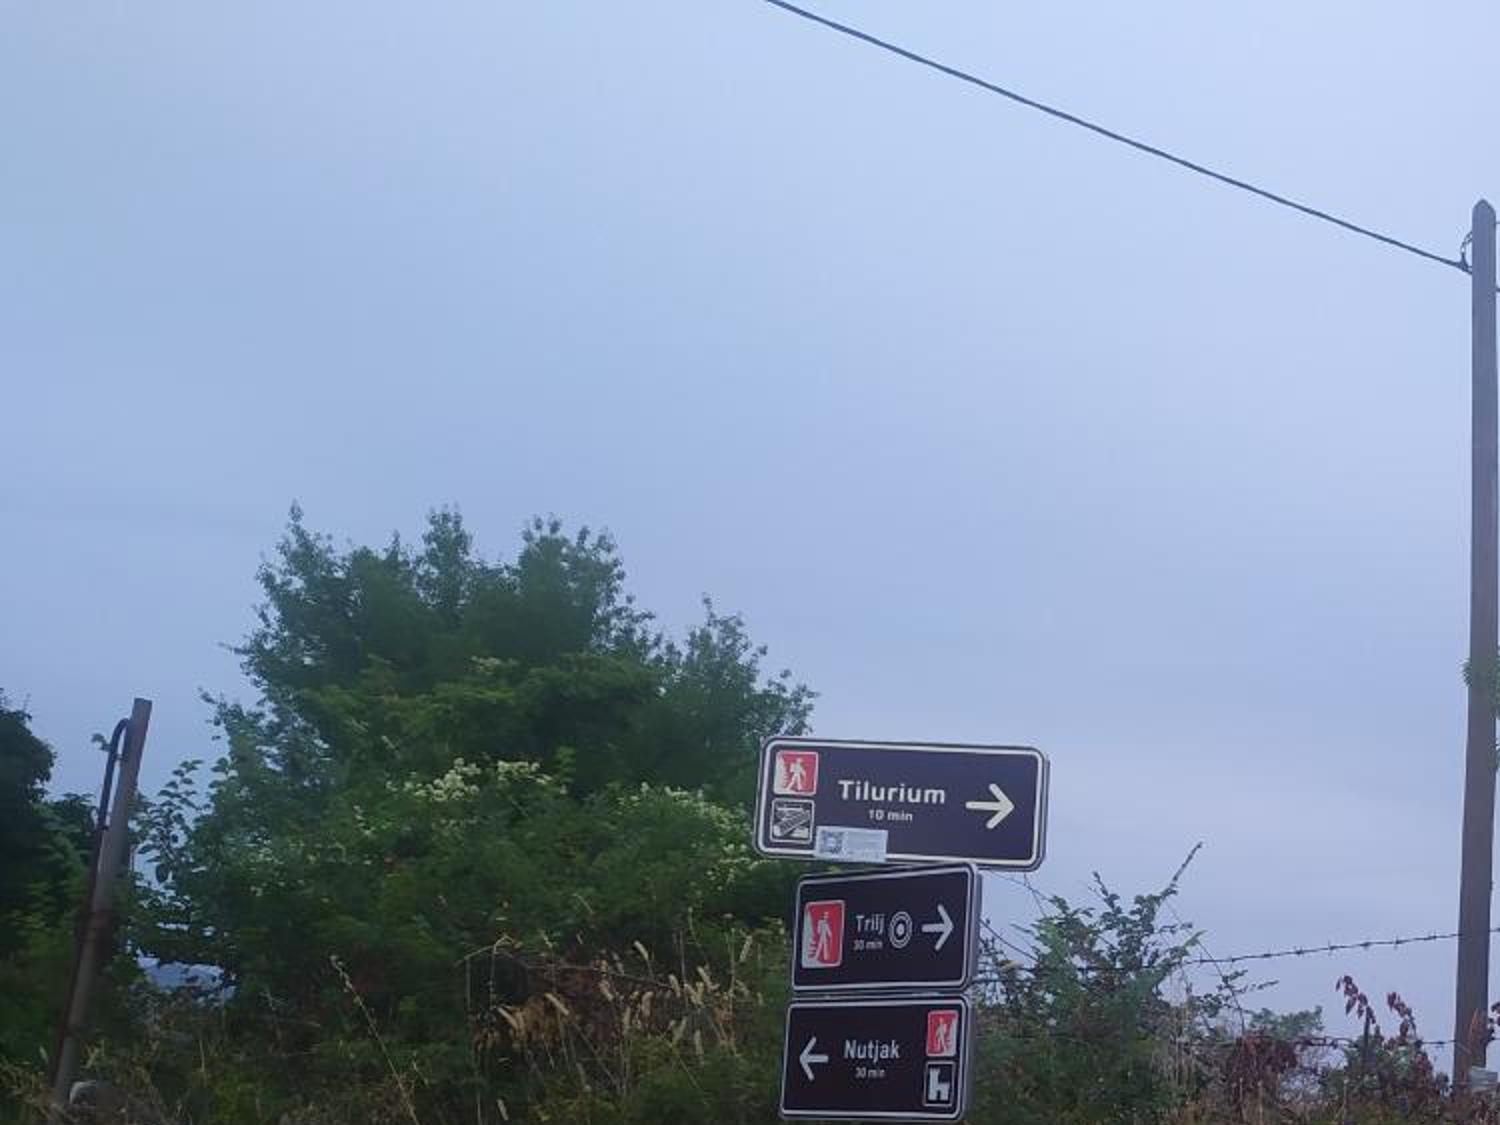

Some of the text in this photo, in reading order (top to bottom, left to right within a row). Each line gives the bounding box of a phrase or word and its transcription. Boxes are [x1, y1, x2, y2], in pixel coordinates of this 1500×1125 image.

[838, 780, 946, 803] Tilurium
[869, 810, 913, 822] 10 min
[855, 913, 885, 936] Trilj
[866, 939, 883, 950] min
[844, 1040, 900, 1062] Nutjak
[855, 1067, 885, 1078] 30 min
